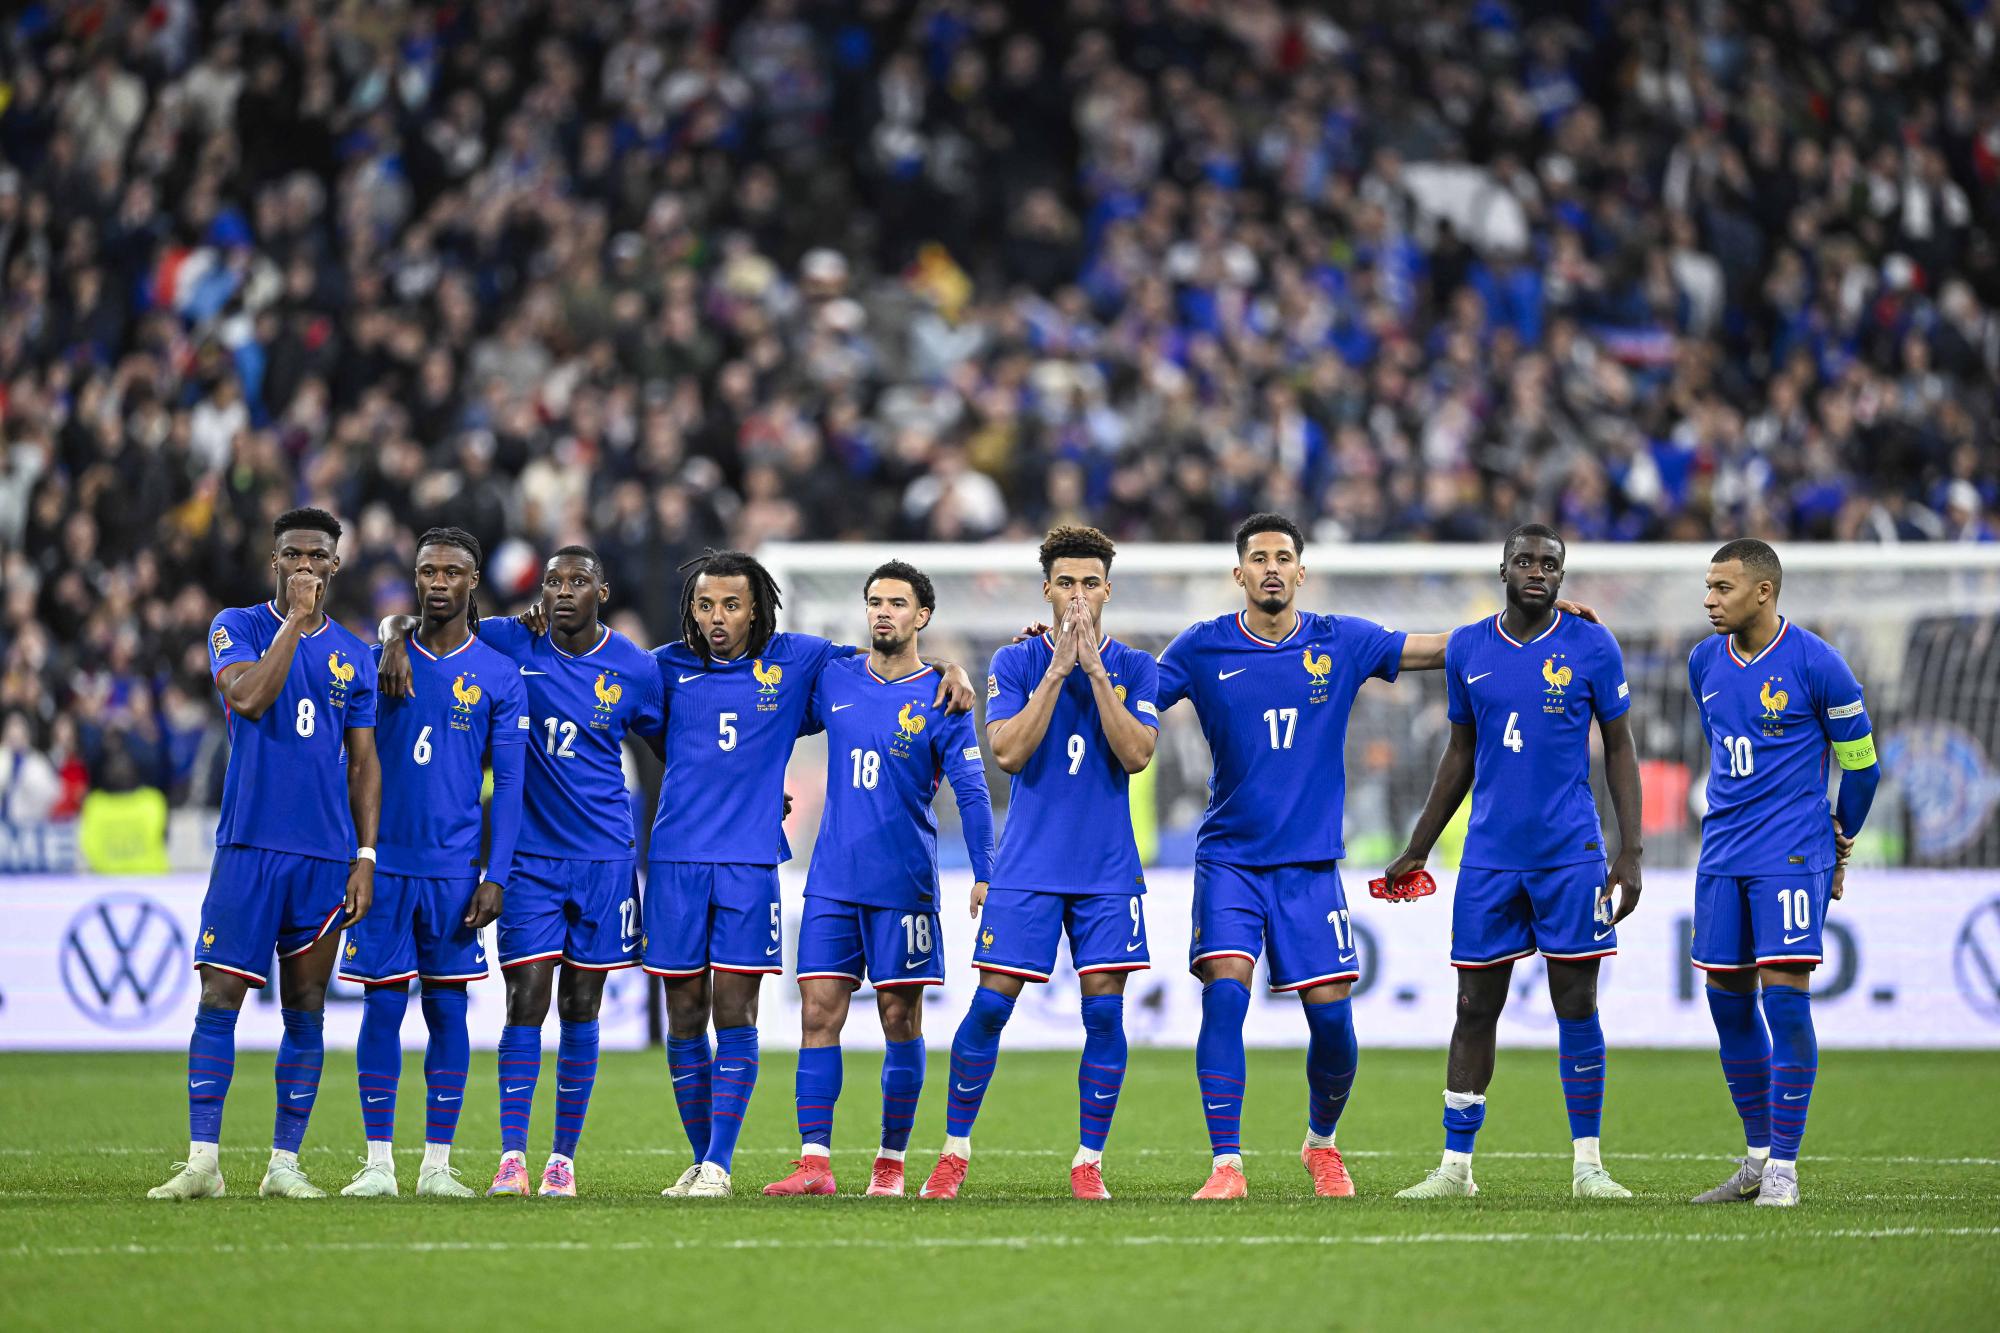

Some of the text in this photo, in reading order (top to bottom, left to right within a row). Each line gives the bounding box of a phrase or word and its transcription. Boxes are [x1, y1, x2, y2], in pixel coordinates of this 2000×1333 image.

[295, 698, 316, 739] 8
[544, 716, 579, 760] 12
[718, 712, 738, 752] 5
[1263, 707, 1299, 751] 17
[1502, 711, 1524, 753] 4
[413, 725, 433, 766] 6
[1067, 734, 1087, 776] 9
[1723, 735, 1754, 778] 10
[850, 748, 882, 792] 18
[619, 897, 642, 940] 12
[770, 902, 780, 943] 5
[1129, 896, 1140, 938] 9
[1593, 886, 1610, 925] 4
[1777, 888, 1811, 932] 10
[901, 914, 932, 956] 18
[1326, 909, 1353, 950] 17
